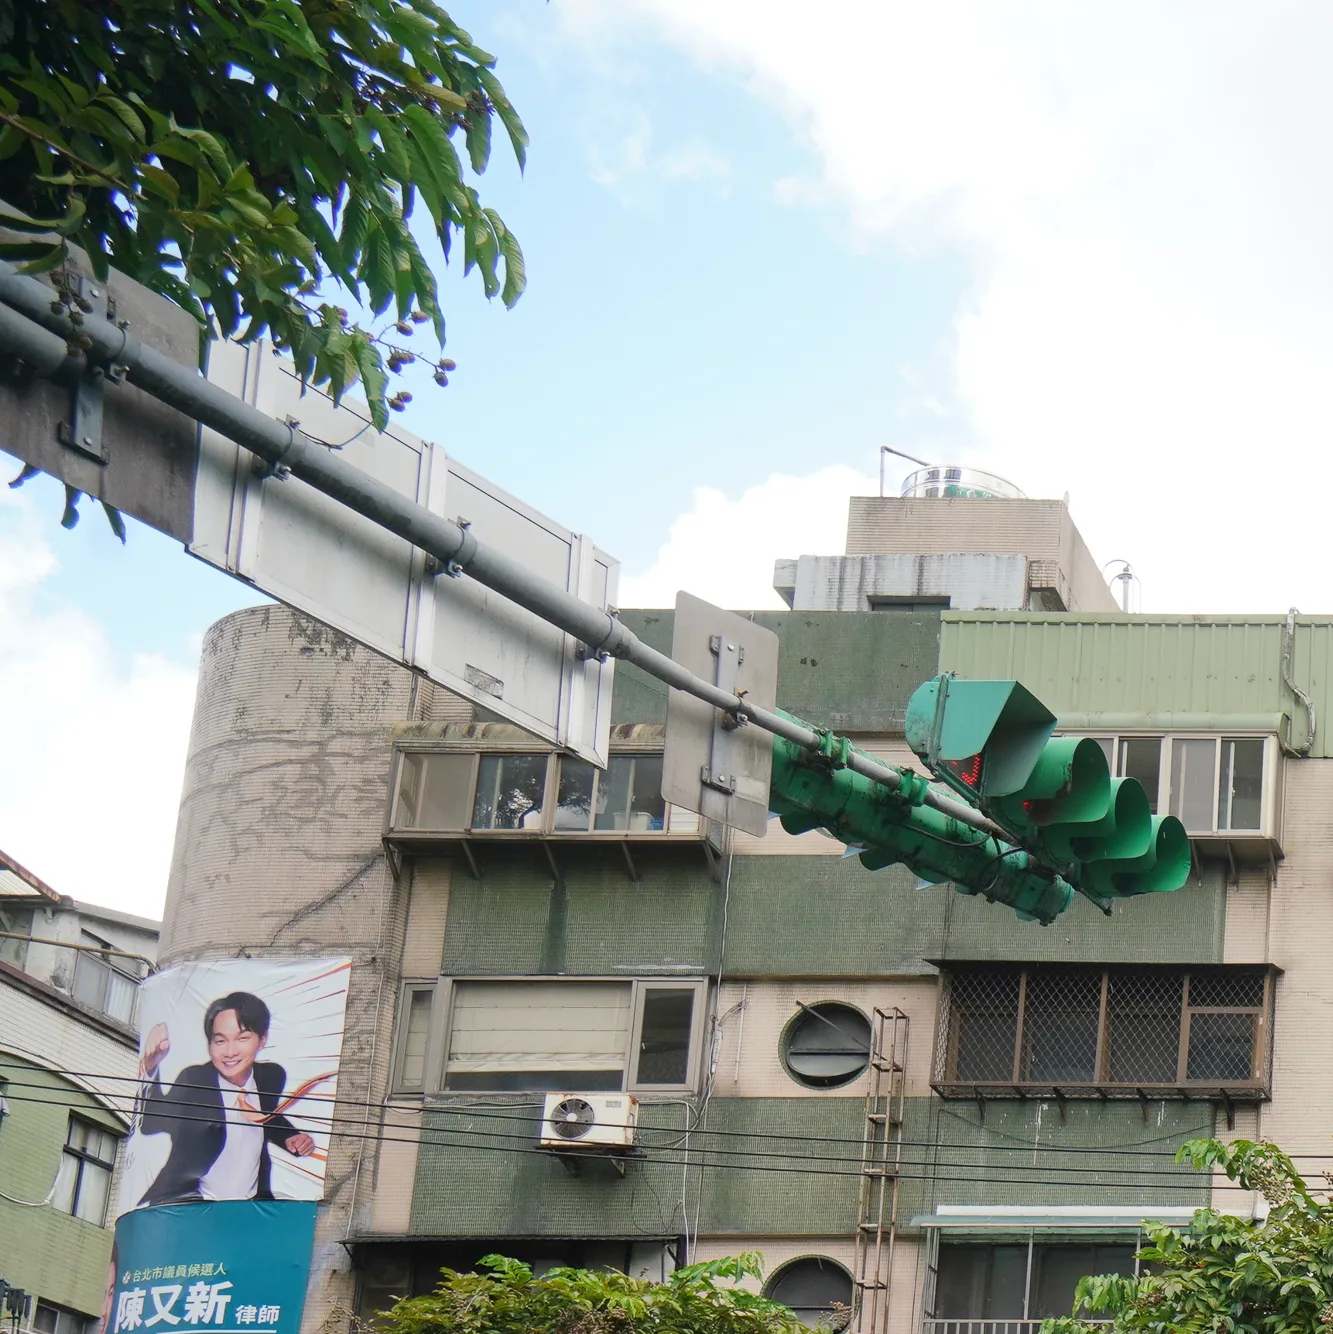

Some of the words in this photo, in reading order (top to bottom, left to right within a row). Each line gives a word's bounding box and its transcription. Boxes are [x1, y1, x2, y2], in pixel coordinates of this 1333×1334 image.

[132, 1262, 227, 1283] 台北市議員候選人
[113, 1280, 234, 1334] 陳又新
[235, 1304, 281, 1325] 律師
